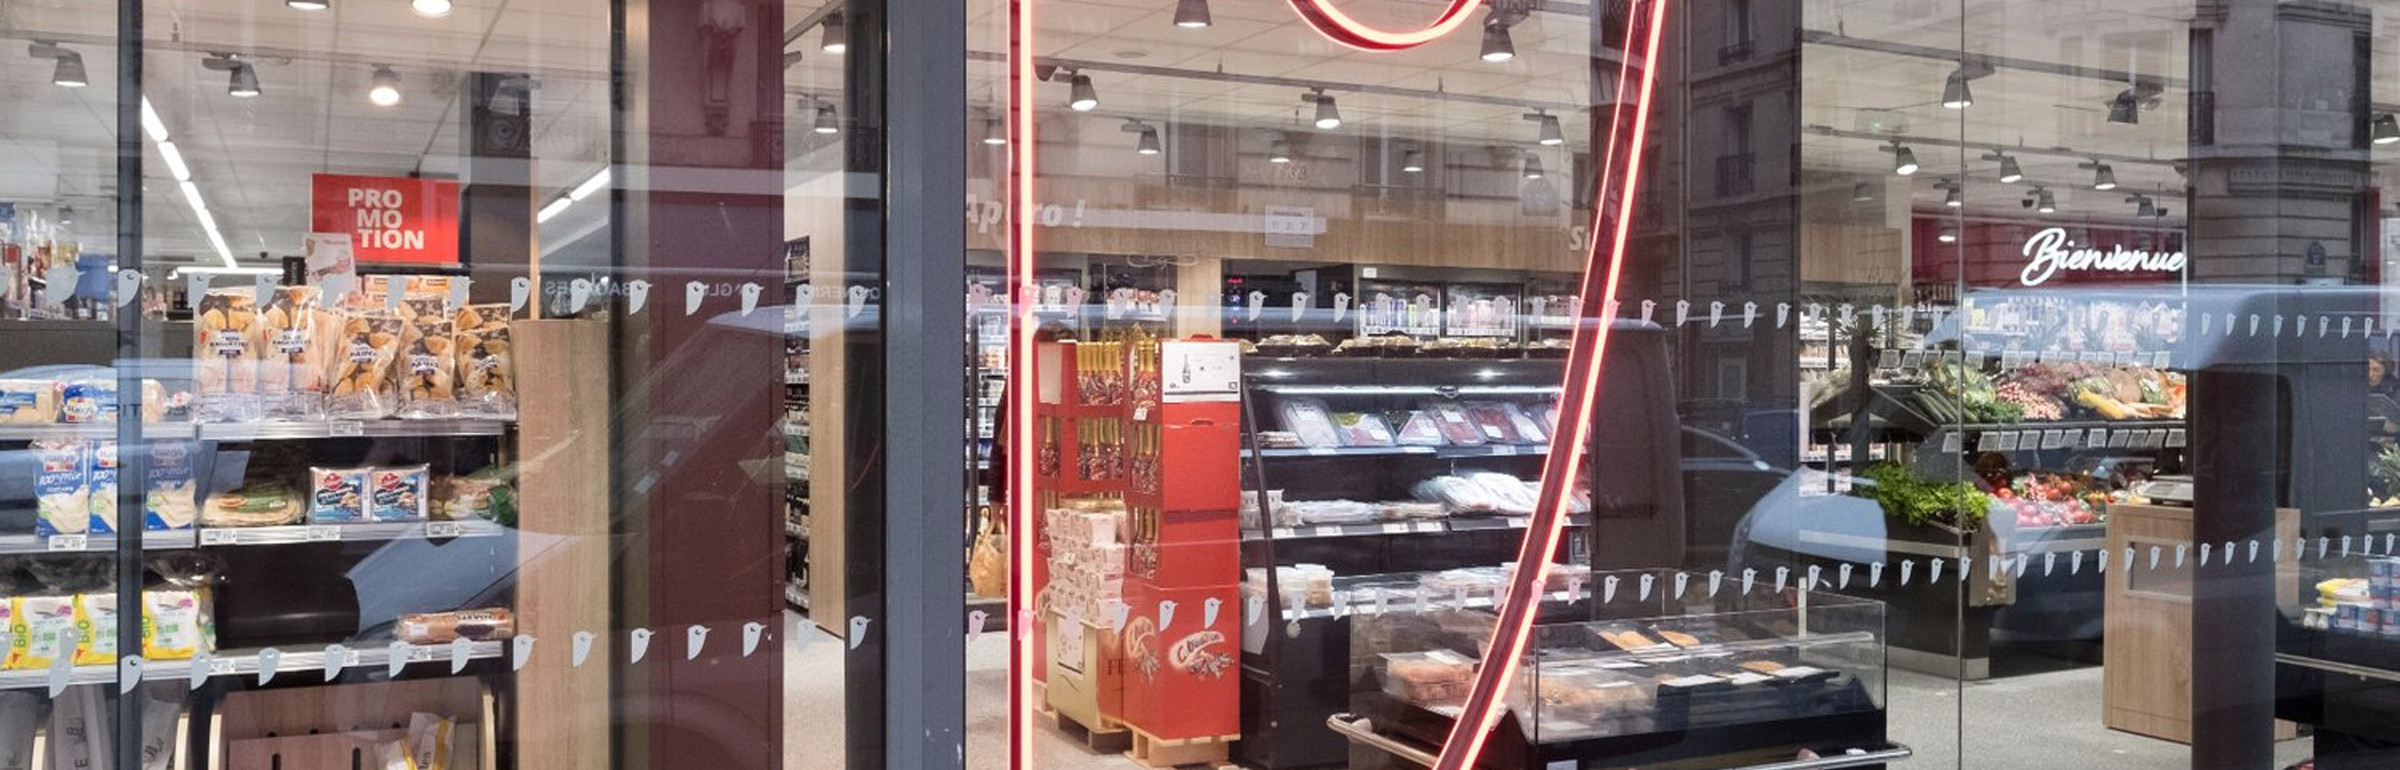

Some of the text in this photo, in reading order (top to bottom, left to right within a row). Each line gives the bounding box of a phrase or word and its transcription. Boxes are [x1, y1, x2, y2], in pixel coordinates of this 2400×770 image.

[348, 188, 403, 209] PRO
[357, 208, 403, 229] MO
[966, 193, 1063, 234] Apro
[357, 229, 425, 250] TION
[2020, 227, 2187, 286] Bienvenue
